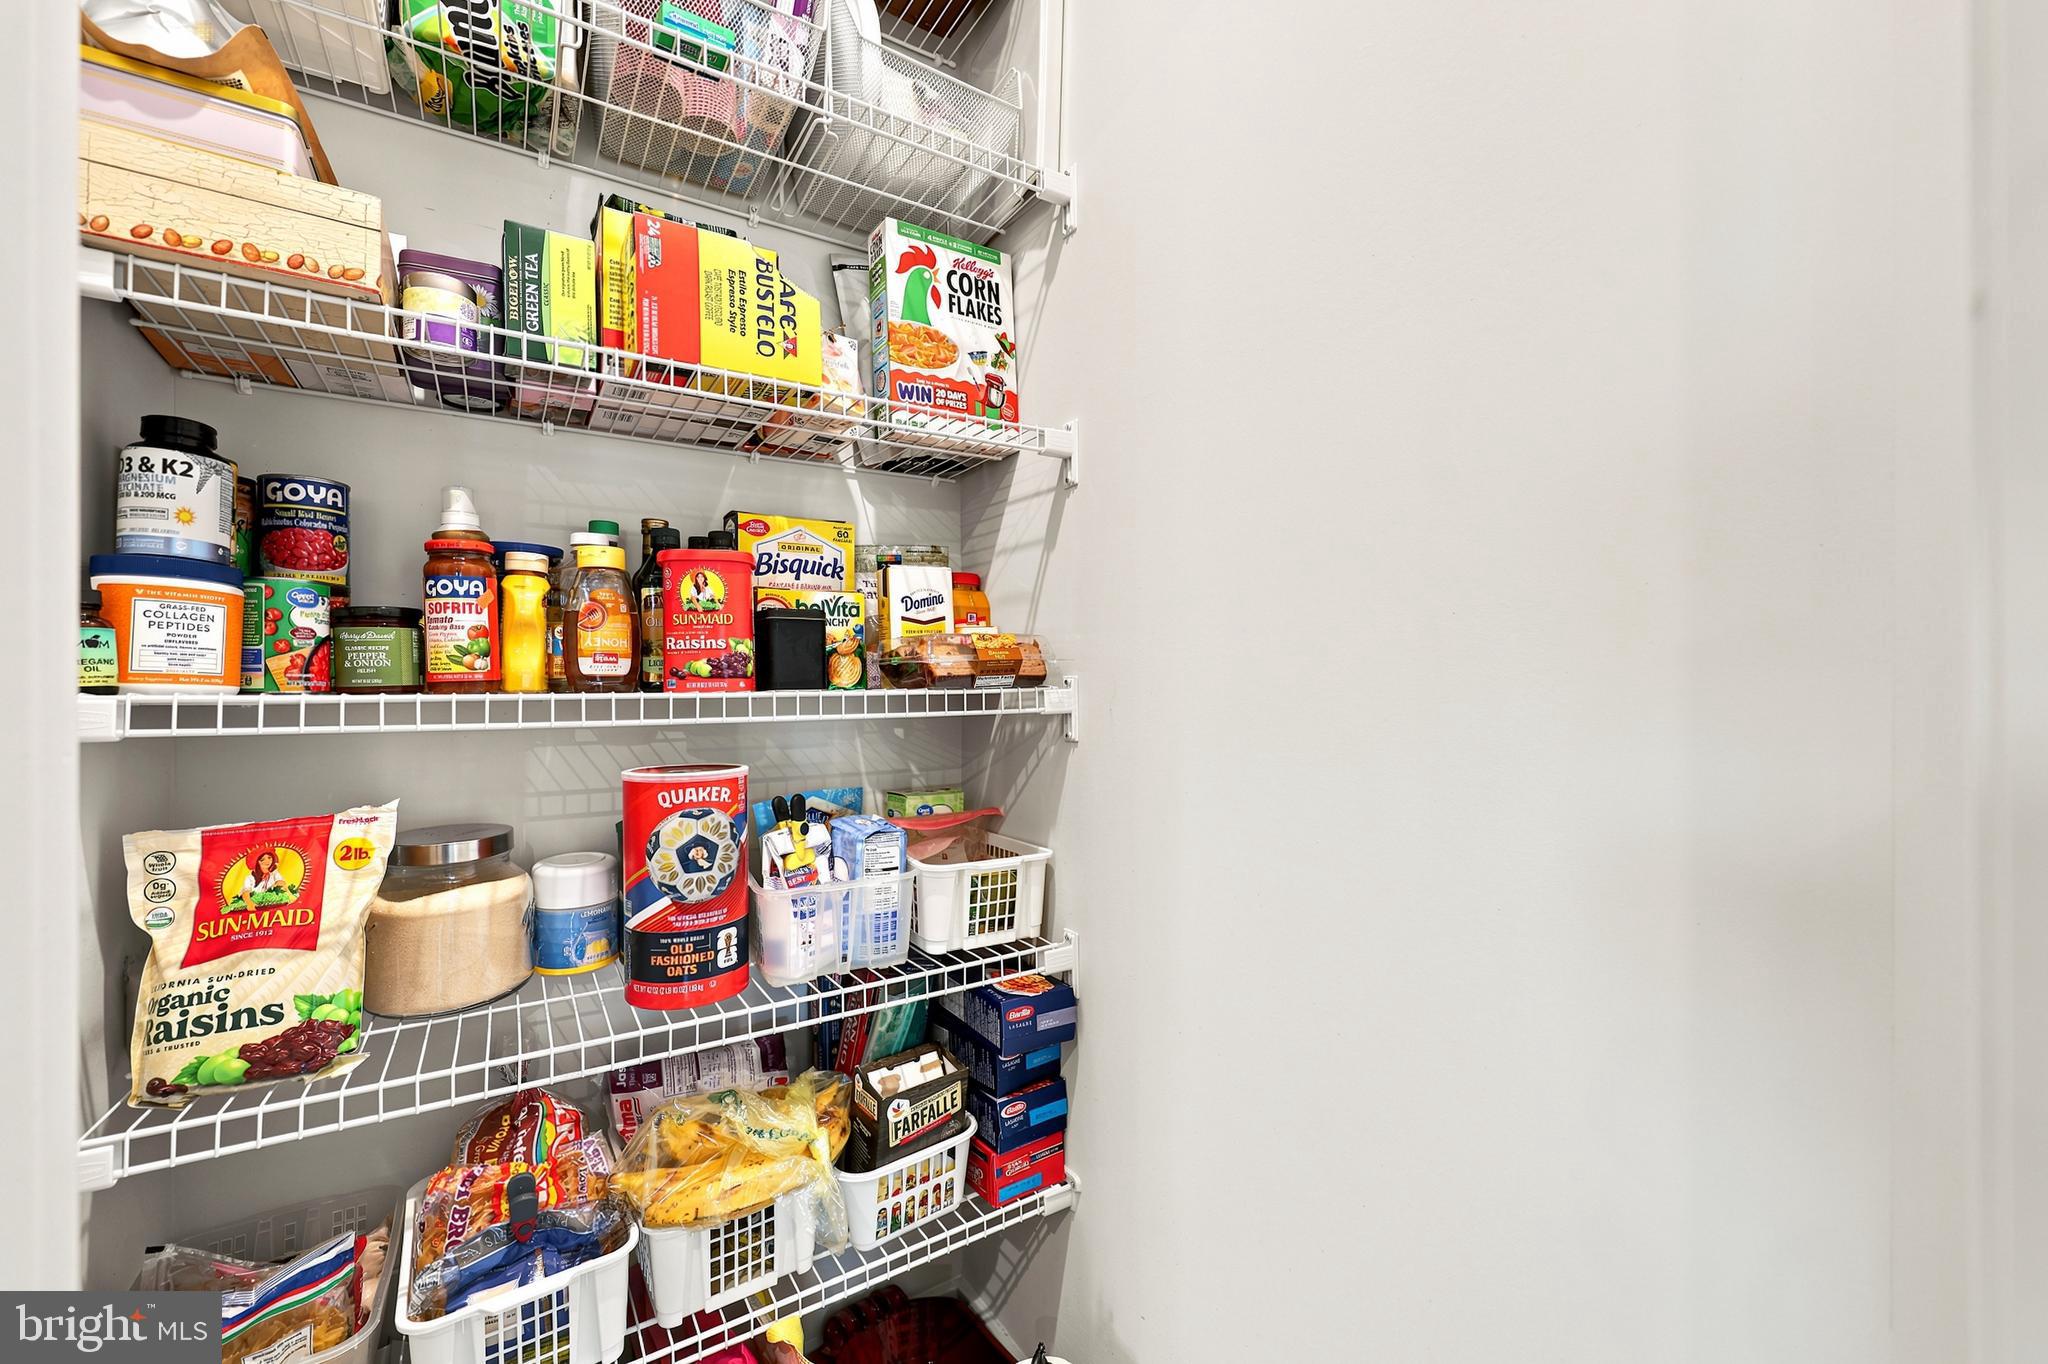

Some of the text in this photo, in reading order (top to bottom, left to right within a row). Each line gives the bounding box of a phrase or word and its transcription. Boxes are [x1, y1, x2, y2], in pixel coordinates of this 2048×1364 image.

[439, 0, 525, 101] Boun
[646, 218, 661, 238] 24
[952, 256, 994, 280] Kellogg's
[508, 254, 519, 322] BIGELOW
[524, 252, 539, 333] GREEN TEA
[946, 268, 1001, 307] CORN
[727, 268, 737, 334] Espresso Style
[737, 269, 747, 337] Estilo Espresso
[777, 262, 798, 336] AFÉ
[755, 257, 776, 358] BUSTELO
[947, 292, 1003, 327] FLAKES
[897, 381, 933, 404] WIN
[935, 388, 967, 402] 20 DAYS
[935, 397, 967, 410] OF PRIZES
[138, 455, 155, 473] &
[161, 457, 194, 479] K2
[118, 472, 176, 485] AGNESIUM
[156, 492, 176, 500] MCG
[265, 480, 344, 508] GOYA
[837, 531, 849, 539] 60
[781, 545, 820, 553] ORIGINAL
[754, 552, 845, 581] Bisquick
[425, 578, 485, 597] GOYA
[291, 590, 315, 601] Great
[900, 592, 944, 613] Domino
[159, 602, 206, 613] GRASS-FED
[142, 609, 215, 623] COLLAGEN
[427, 616, 454, 625] Tomato
[824, 618, 851, 628] NCHY
[147, 620, 211, 633] PEPTIDES
[582, 636, 628, 648] HONEY
[665, 635, 727, 651] Raisins
[78, 658, 115, 666] EGANO
[347, 651, 387, 660] PEPPER
[83, 665, 102, 673] OIL
[344, 659, 392, 668] & ONION
[656, 785, 732, 810] QUAKER
[787, 876, 808, 887] BEST
[580, 904, 612, 919] LEMONA
[230, 928, 273, 941] SINCE 1912
[670, 943, 694, 955] OLD
[650, 949, 716, 967] FASHIONED
[207, 966, 277, 983] SUN-DRIED
[666, 965, 698, 977] OATS
[1008, 1007, 1031, 1020] Barilla
[163, 1040, 201, 1052] TRUSTED
[617, 1097, 639, 1143] atma
[893, 1089, 959, 1142] FARFALLE
